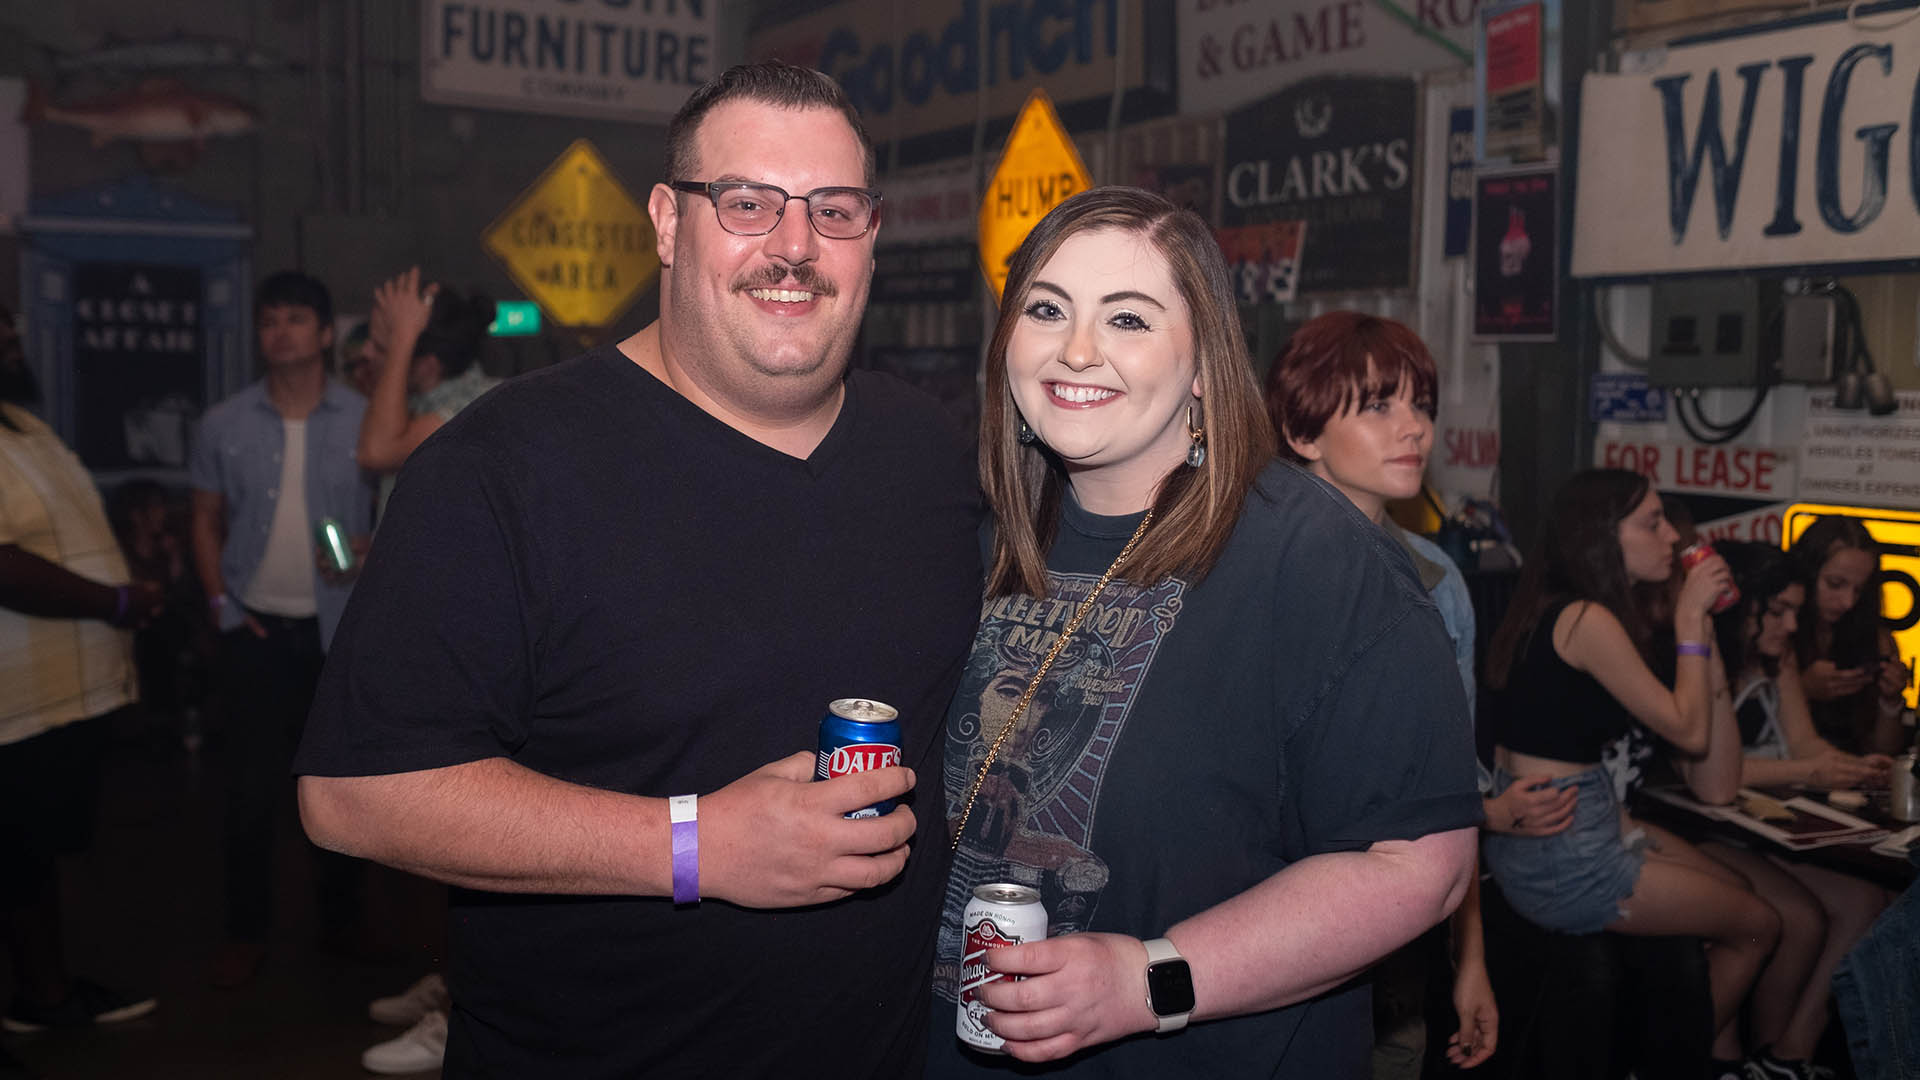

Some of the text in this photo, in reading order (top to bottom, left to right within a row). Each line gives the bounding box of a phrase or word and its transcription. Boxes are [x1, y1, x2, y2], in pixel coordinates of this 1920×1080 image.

[441, 4, 709, 86] FURNITURE
[1197, 2, 1367, 80] & GAME
[1227, 138, 1409, 208] CLARK'S
[1653, 42, 1920, 246] WIG
[995, 172, 1074, 218] HUMP
[511, 217, 652, 253] CONGESTED
[1603, 442, 1774, 492] FOR LEASE
[971, 937, 981, 946] THE
